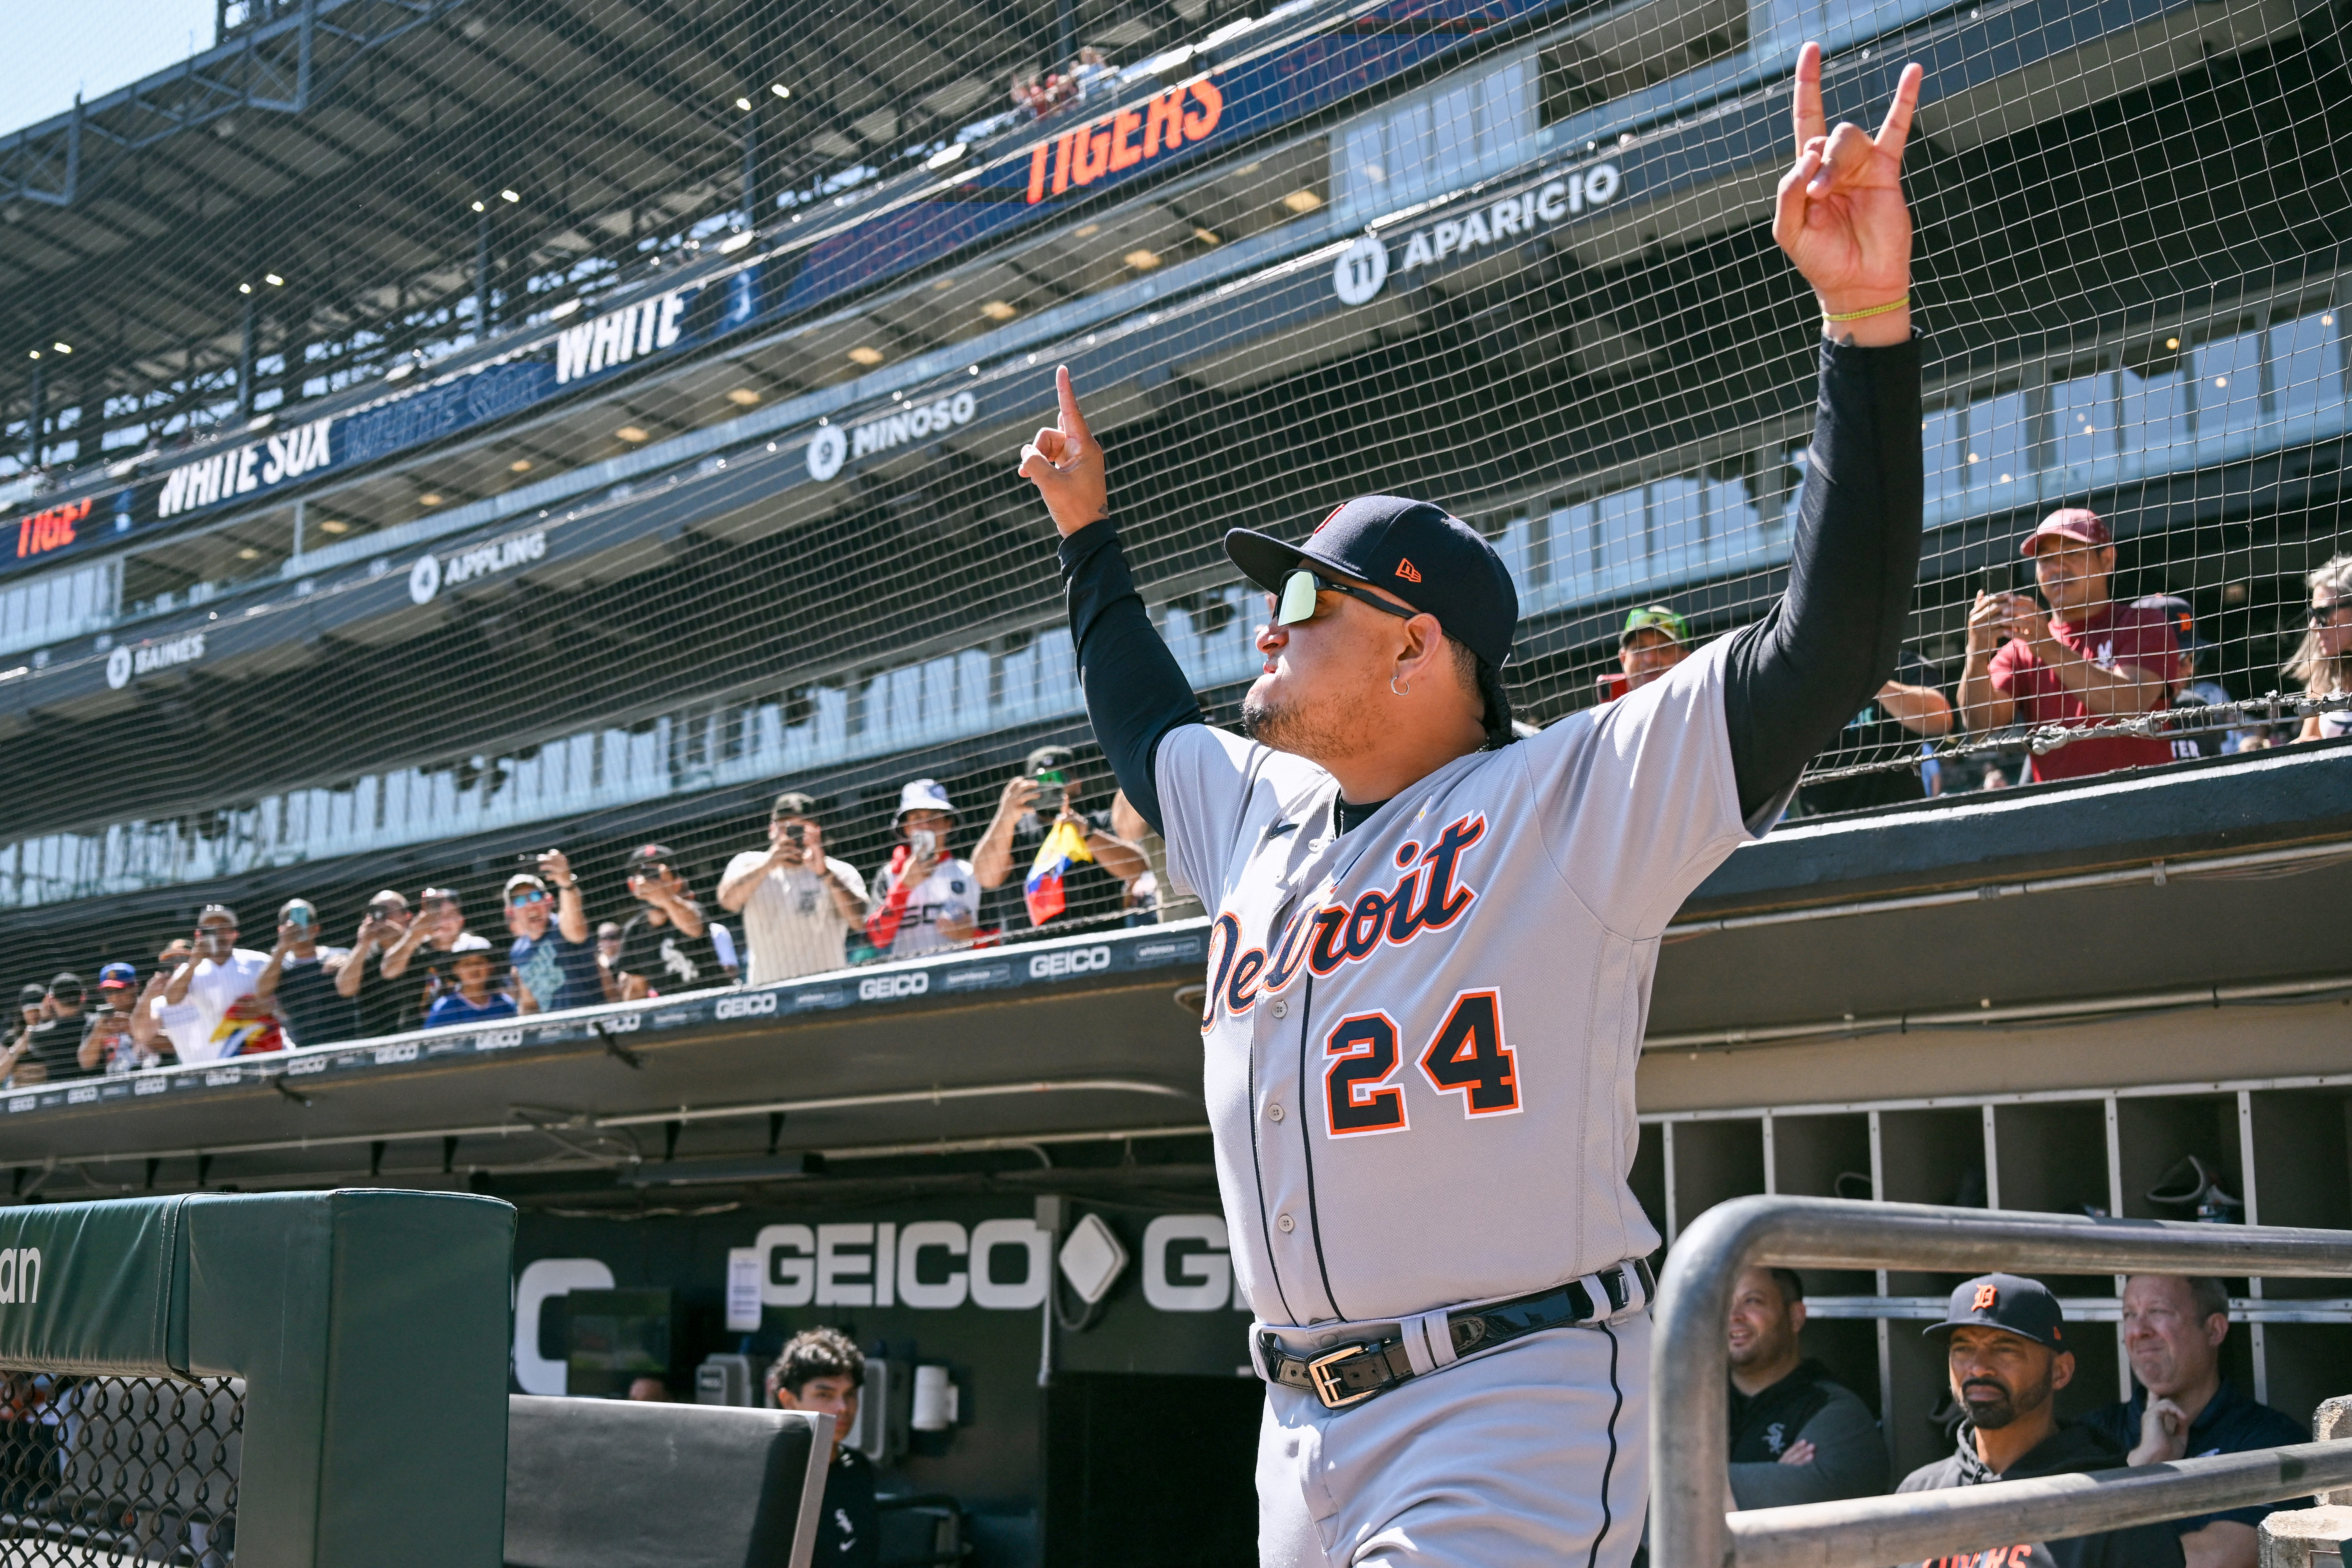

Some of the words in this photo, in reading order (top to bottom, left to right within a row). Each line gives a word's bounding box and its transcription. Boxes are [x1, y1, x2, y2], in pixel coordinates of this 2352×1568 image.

[1026, 69, 1223, 204] TIGERS
[1400, 165, 1620, 272] APARICIO
[556, 289, 684, 384] WHITE
[159, 443, 259, 518] WHITE
[262, 419, 333, 484] SOX
[852, 391, 976, 457] MINOSO
[444, 530, 545, 586] APPLING
[1029, 945, 1111, 979] GEICO
[1201, 809, 1490, 1036] Detroit
[715, 992, 777, 1020] GEICO
[859, 971, 929, 1000] GEICO
[1322, 986, 1524, 1140] 24
[754, 1218, 1051, 1310] GEICO
[1971, 1284, 1997, 1312] D
